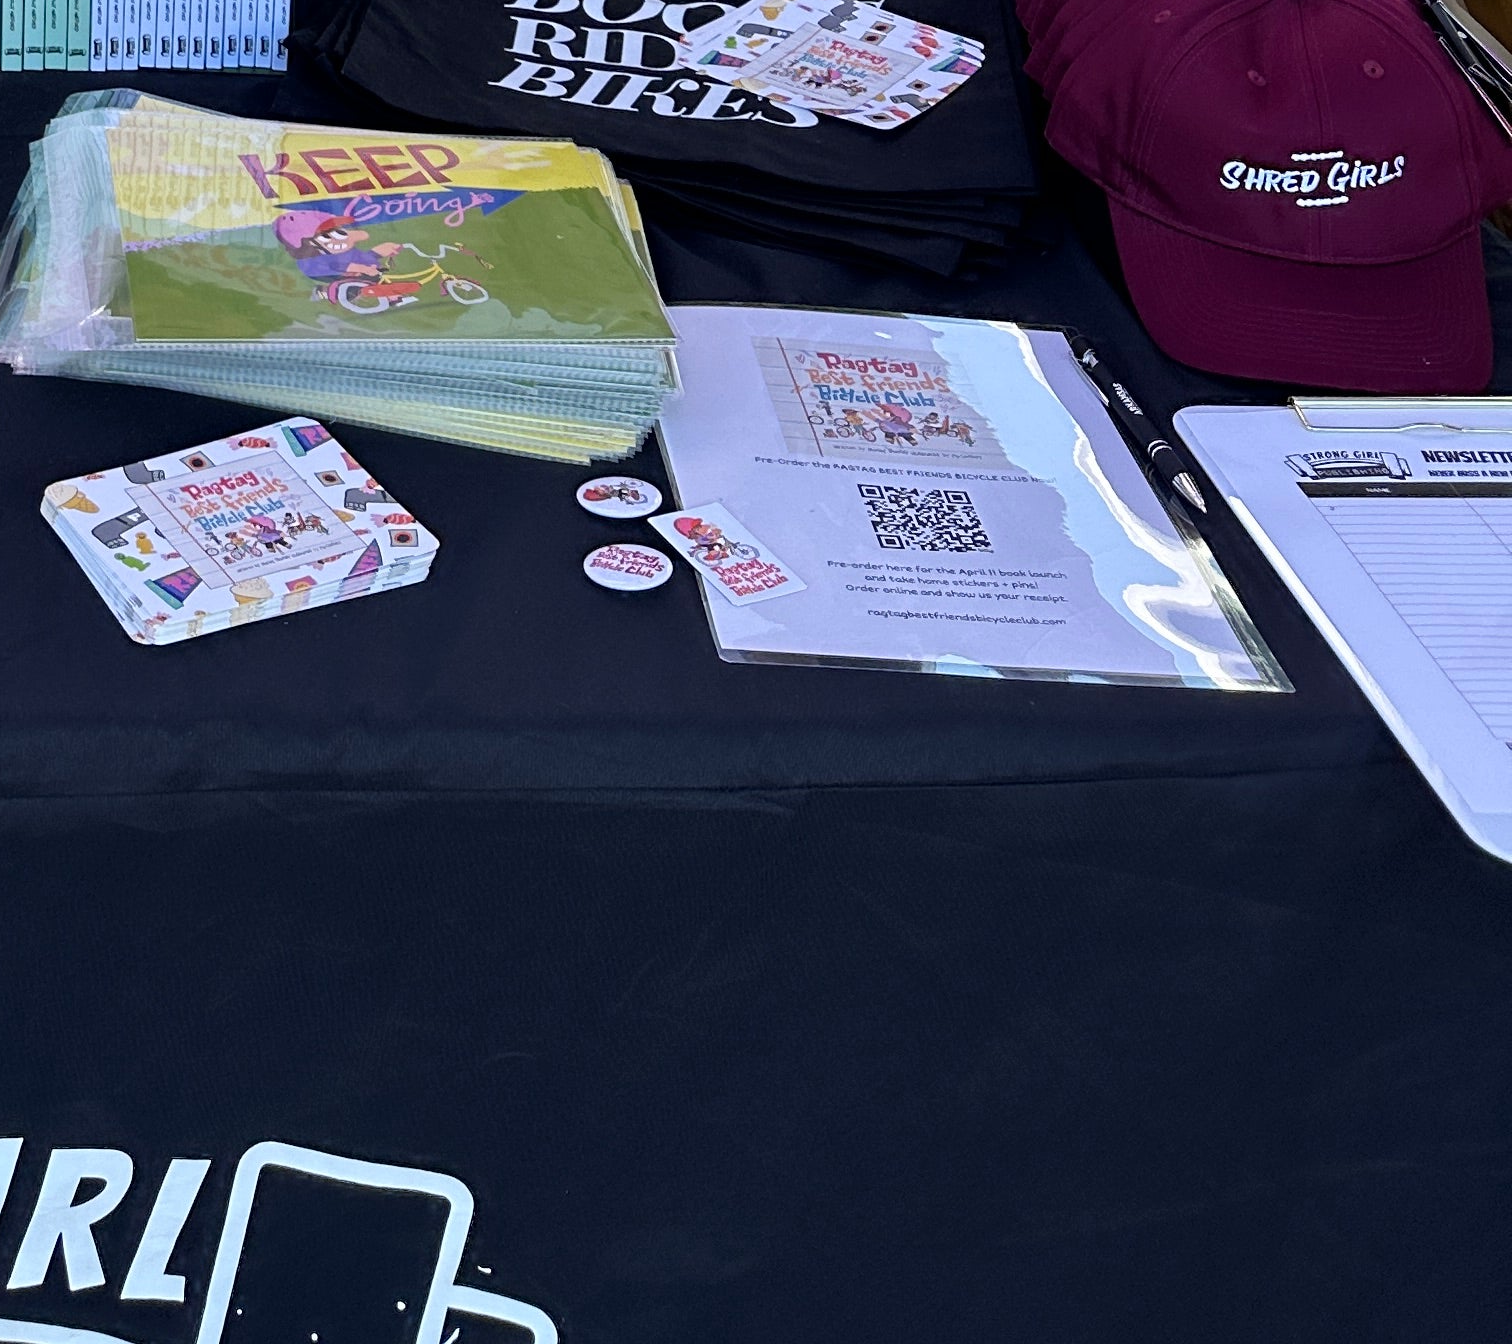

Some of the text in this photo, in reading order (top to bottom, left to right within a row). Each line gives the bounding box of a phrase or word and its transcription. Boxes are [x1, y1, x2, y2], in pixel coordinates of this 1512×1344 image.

[237, 143, 462, 199] KEEP
[1220, 161, 1320, 193] SHRED
[343, 192, 478, 226] Going
[817, 352, 918, 378] Ragtag
[808, 369, 856, 386] Best
[885, 390, 935, 407] Club
[1303, 451, 1348, 461] STRONG
[180, 471, 260, 501] Ragtag
[245, 498, 285, 517] Club
[865, 574, 886, 583] and
[889, 575, 915, 585] take
[952, 579, 1000, 588] stickers
